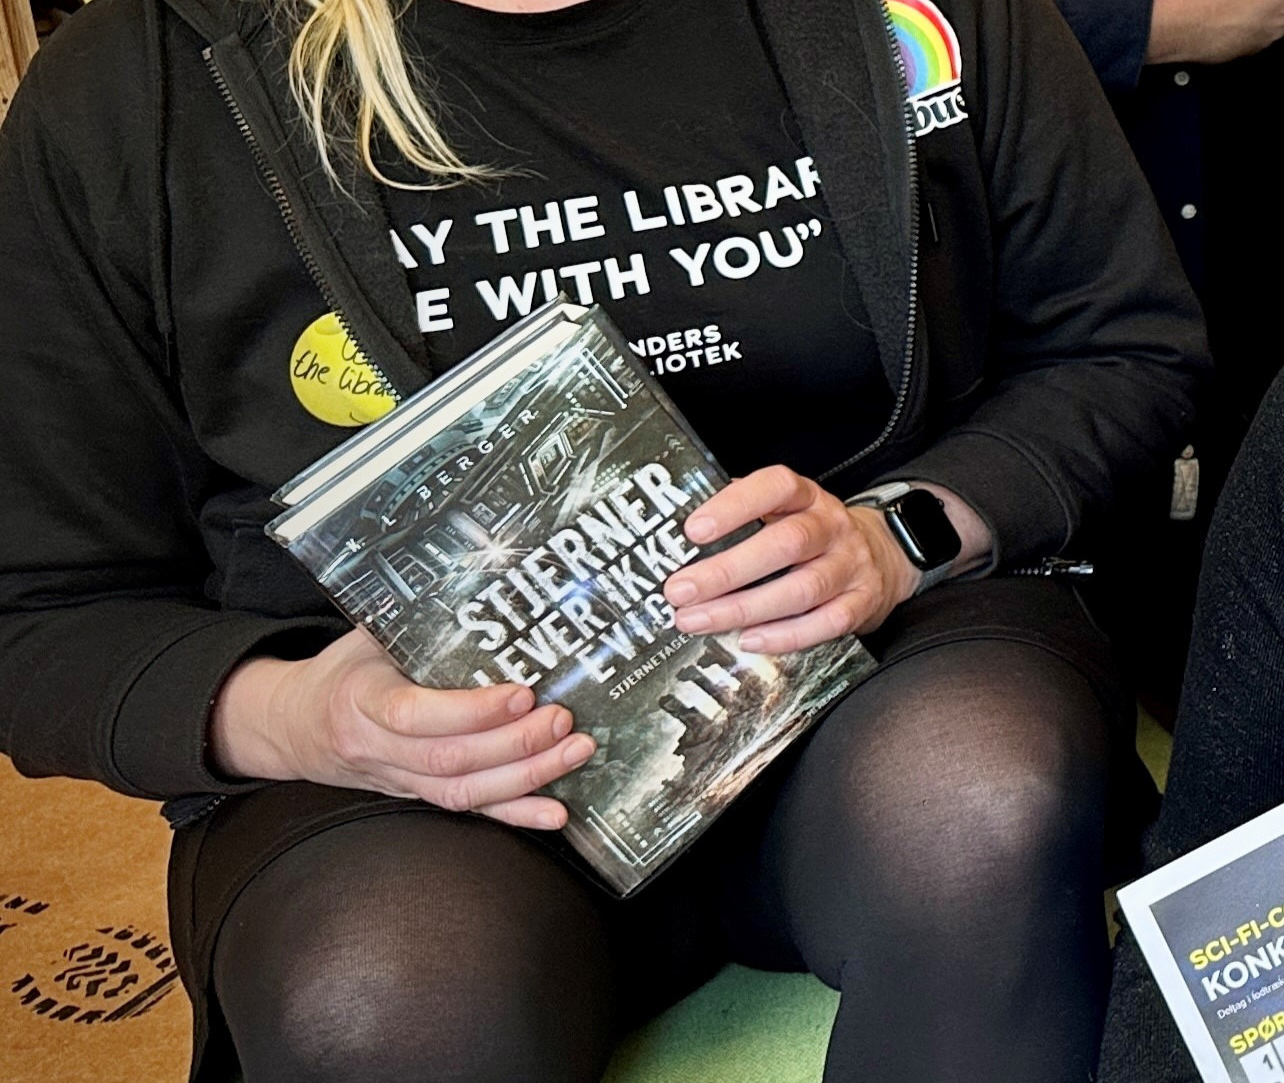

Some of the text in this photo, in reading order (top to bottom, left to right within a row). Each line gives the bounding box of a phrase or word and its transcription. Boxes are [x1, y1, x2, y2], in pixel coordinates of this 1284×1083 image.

[475, 195, 606, 255] THE
[623, 156, 822, 232] LIBRAR
[416, 288, 454, 333] E
[475, 254, 650, 321] WITH
[293, 350, 389, 398] the libra
[629, 325, 722, 359] NDERS
[650, 341, 743, 376] IOTEK
[416, 409, 540, 501] BERGER
[457, 463, 691, 652] STJERNER
[597, 519, 700, 611] IKKE
[576, 593, 676, 684] EVIG
[1215, 997, 1248, 1020] Deltag
[1259, 1052, 1275, 1072] 1
